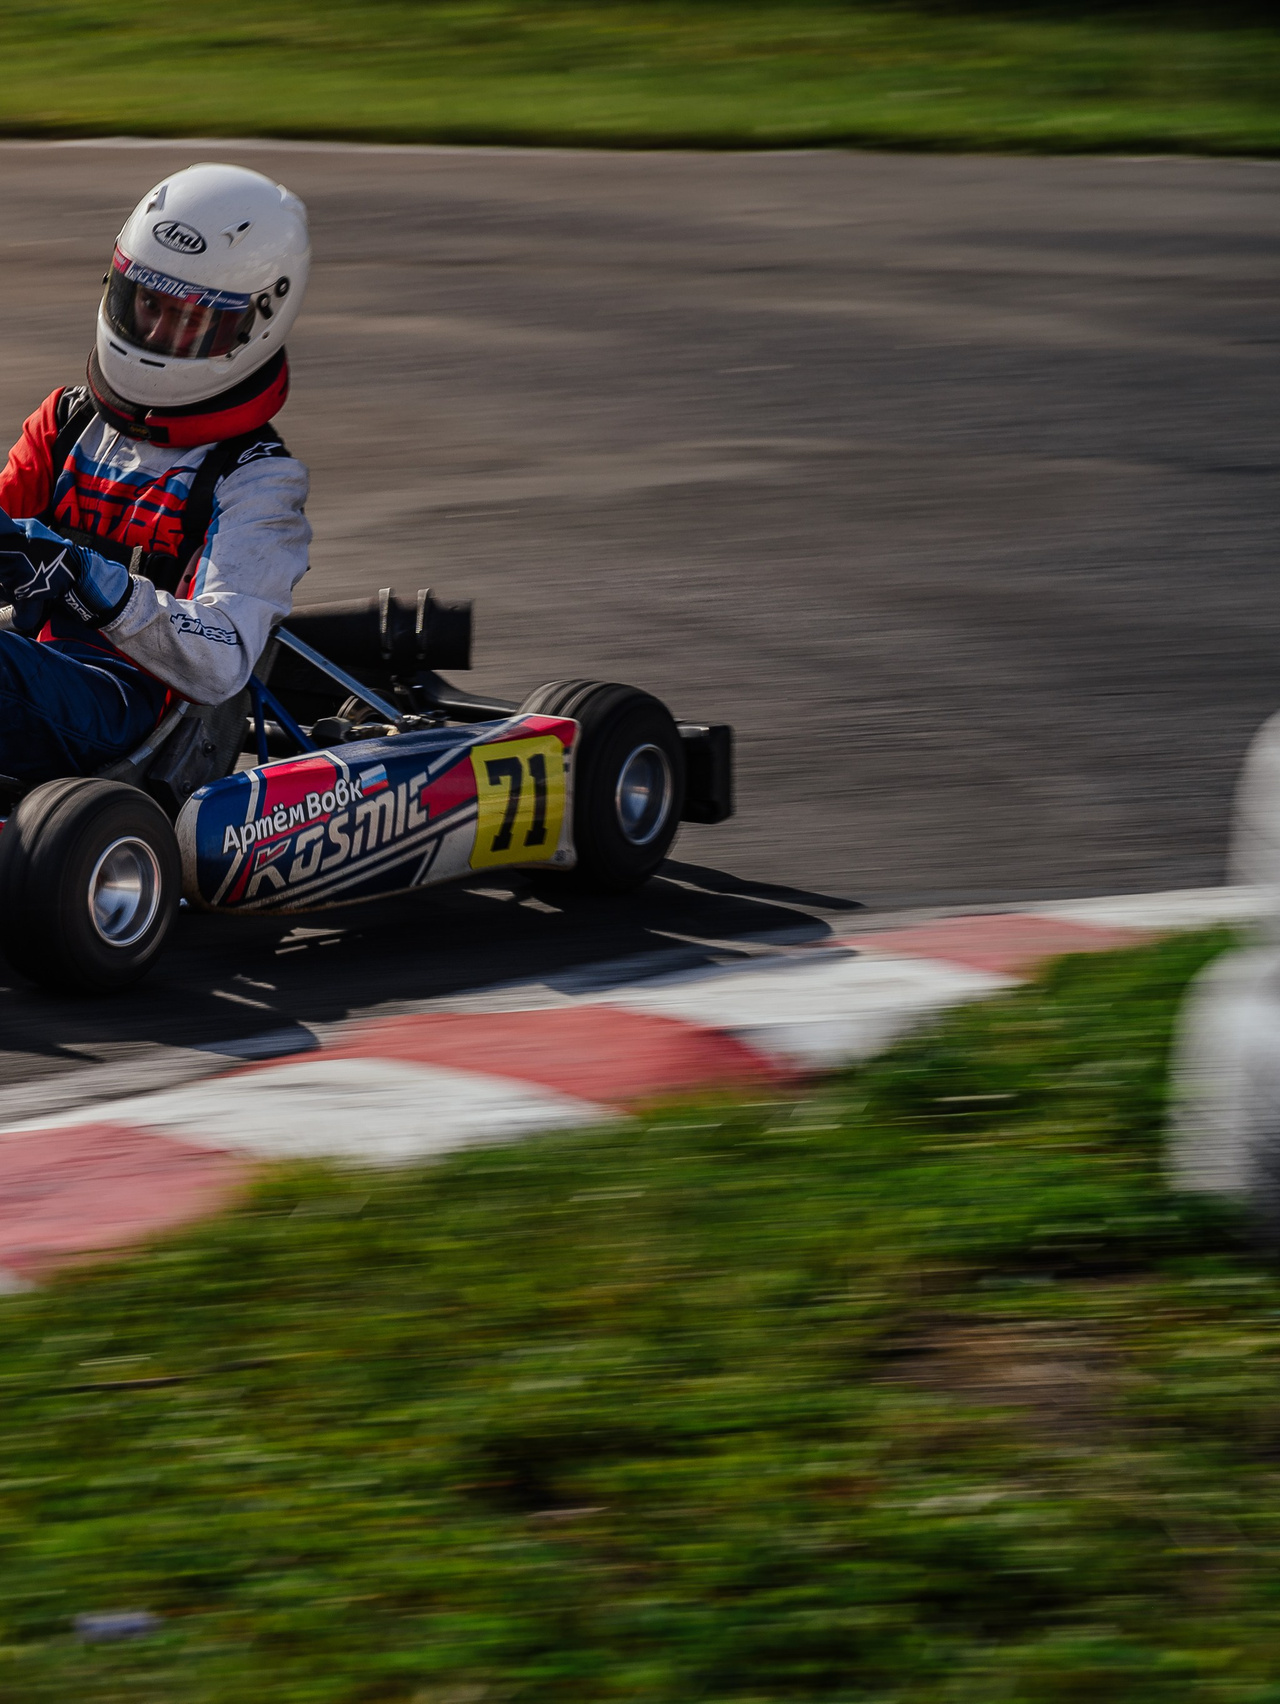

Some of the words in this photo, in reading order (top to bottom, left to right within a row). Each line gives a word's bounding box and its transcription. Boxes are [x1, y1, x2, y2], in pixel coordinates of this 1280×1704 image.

[222, 803, 305, 854] Артём
[305, 778, 364, 821] Вовк
[484, 753, 547, 852] 71
